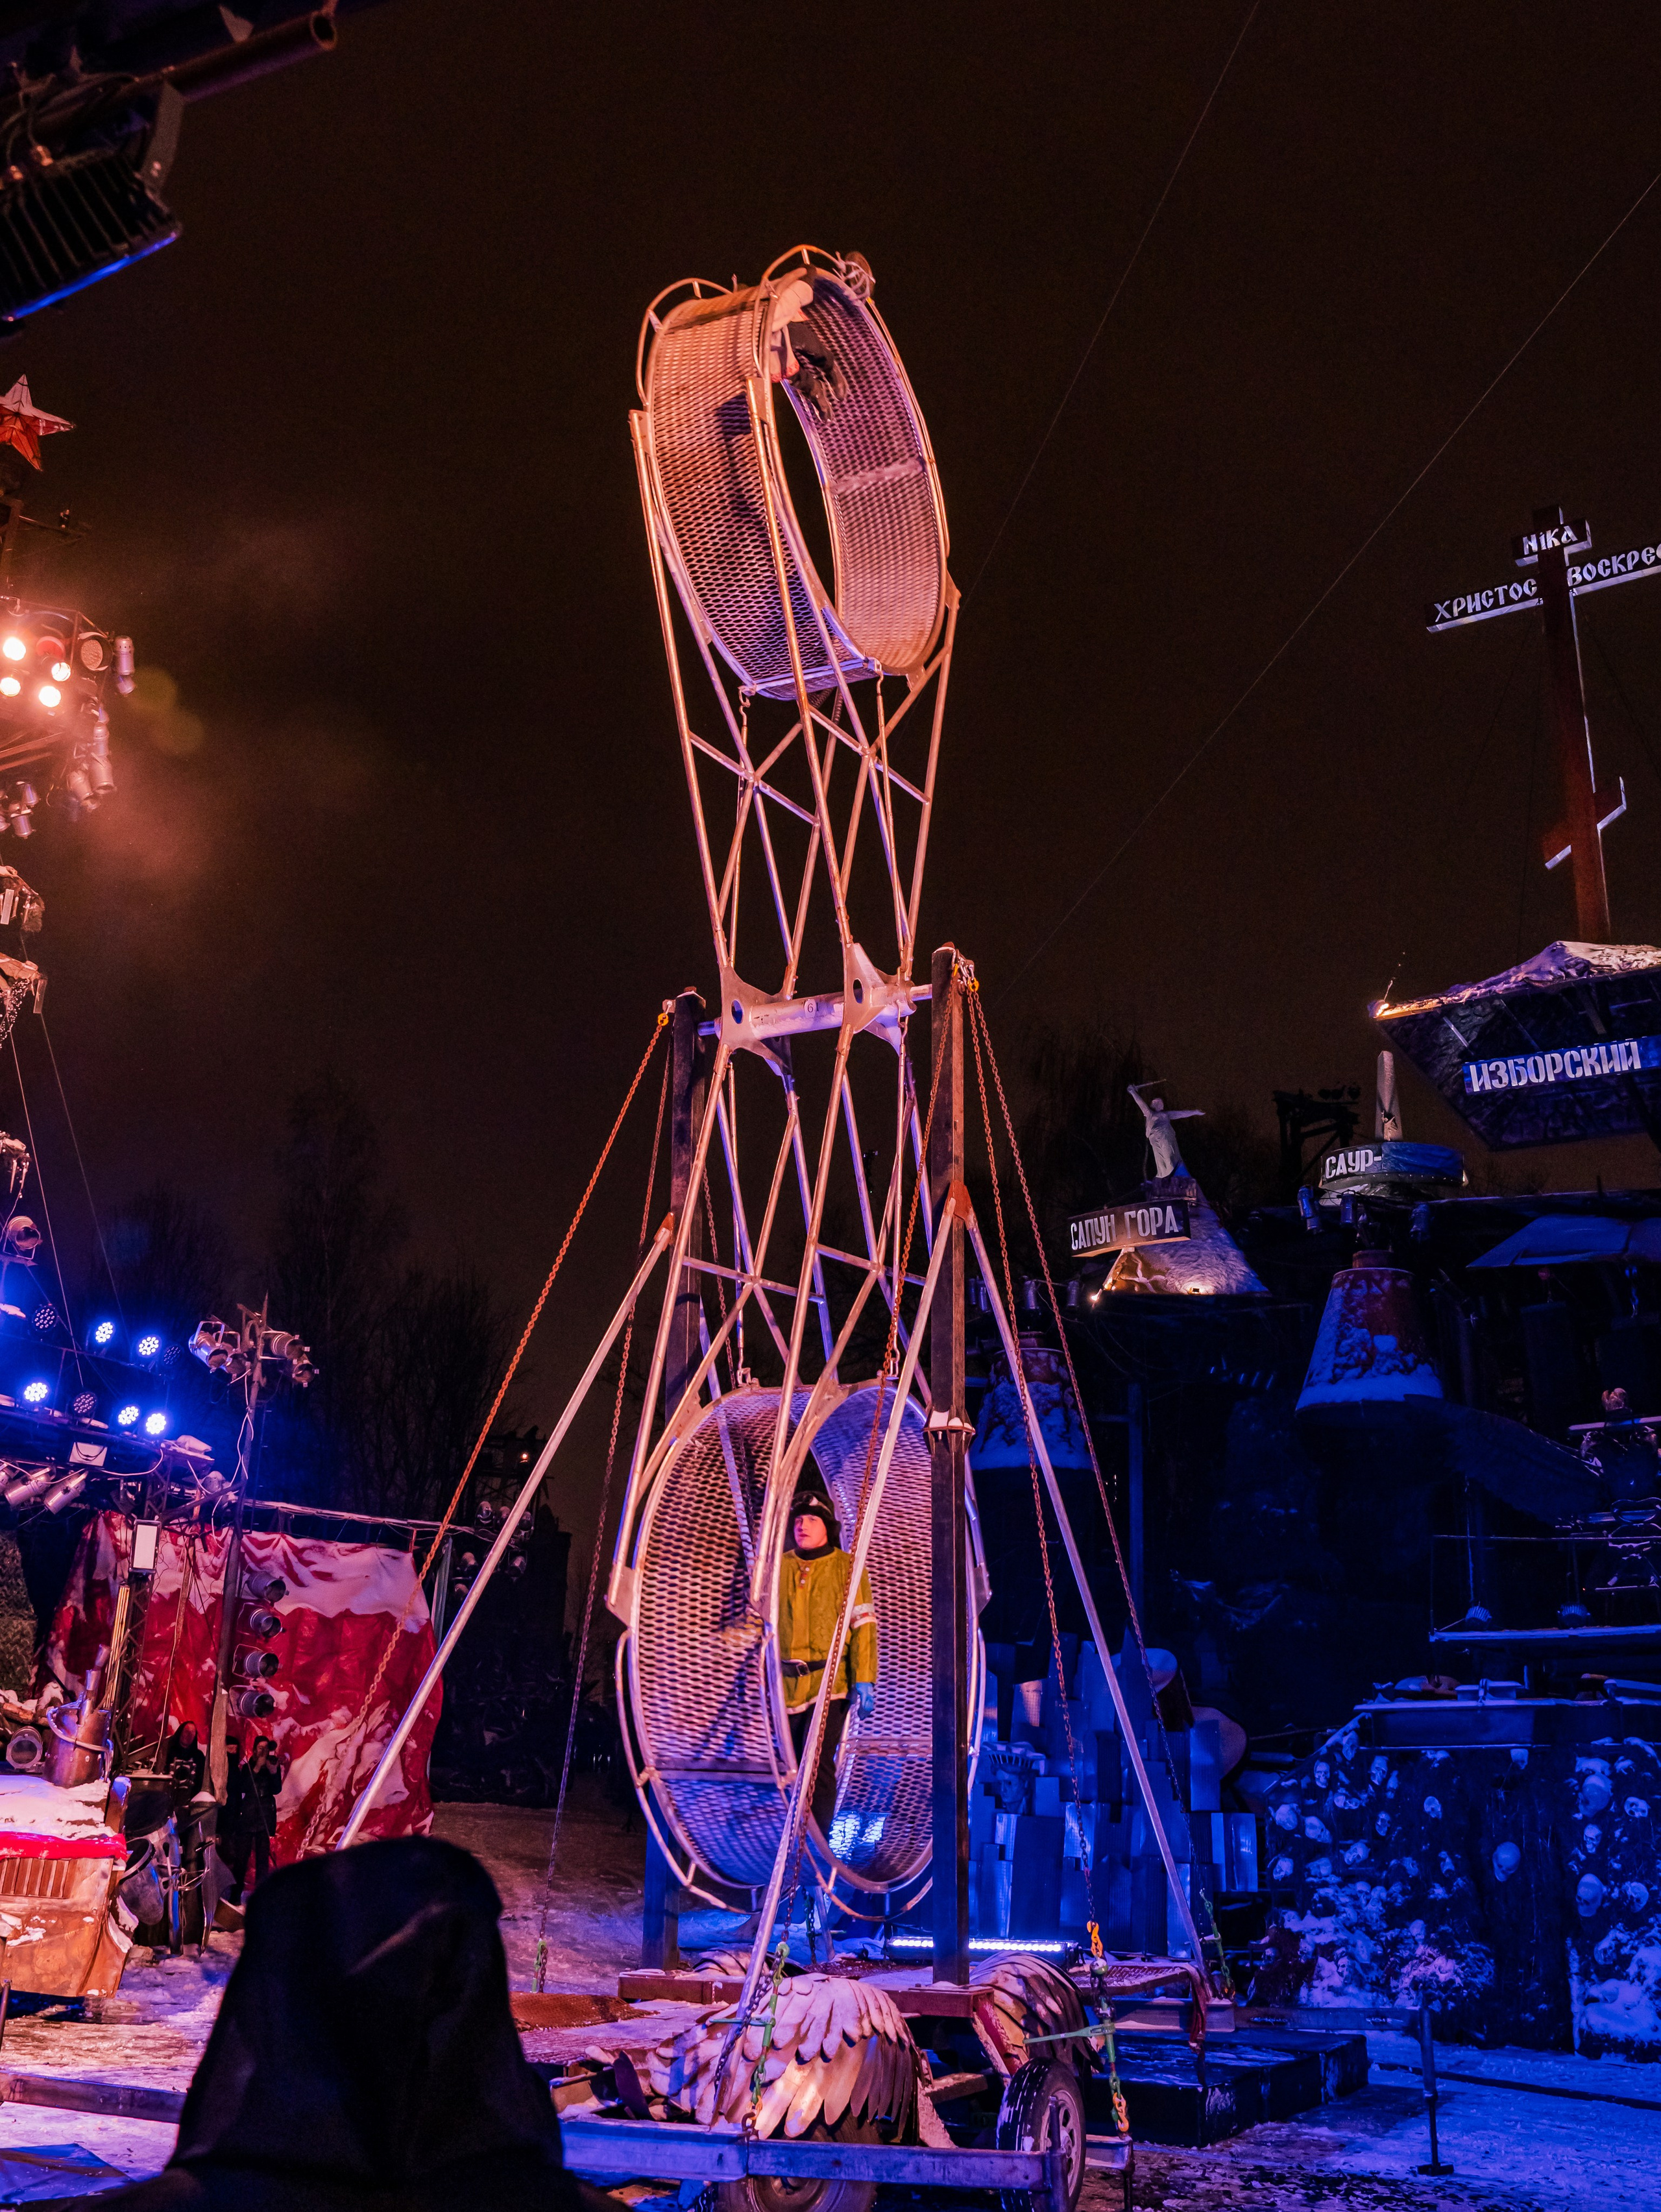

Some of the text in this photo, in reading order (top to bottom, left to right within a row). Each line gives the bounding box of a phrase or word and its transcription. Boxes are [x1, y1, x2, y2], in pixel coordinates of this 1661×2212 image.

[1434, 578, 1538, 623] ХРИСТОС
[1469, 1040, 1642, 1092] ИЗБОРСКИЙ
[1325, 1149, 1382, 1179] САУР-
[1071, 1205, 1180, 1251] САПУН ГОРА
